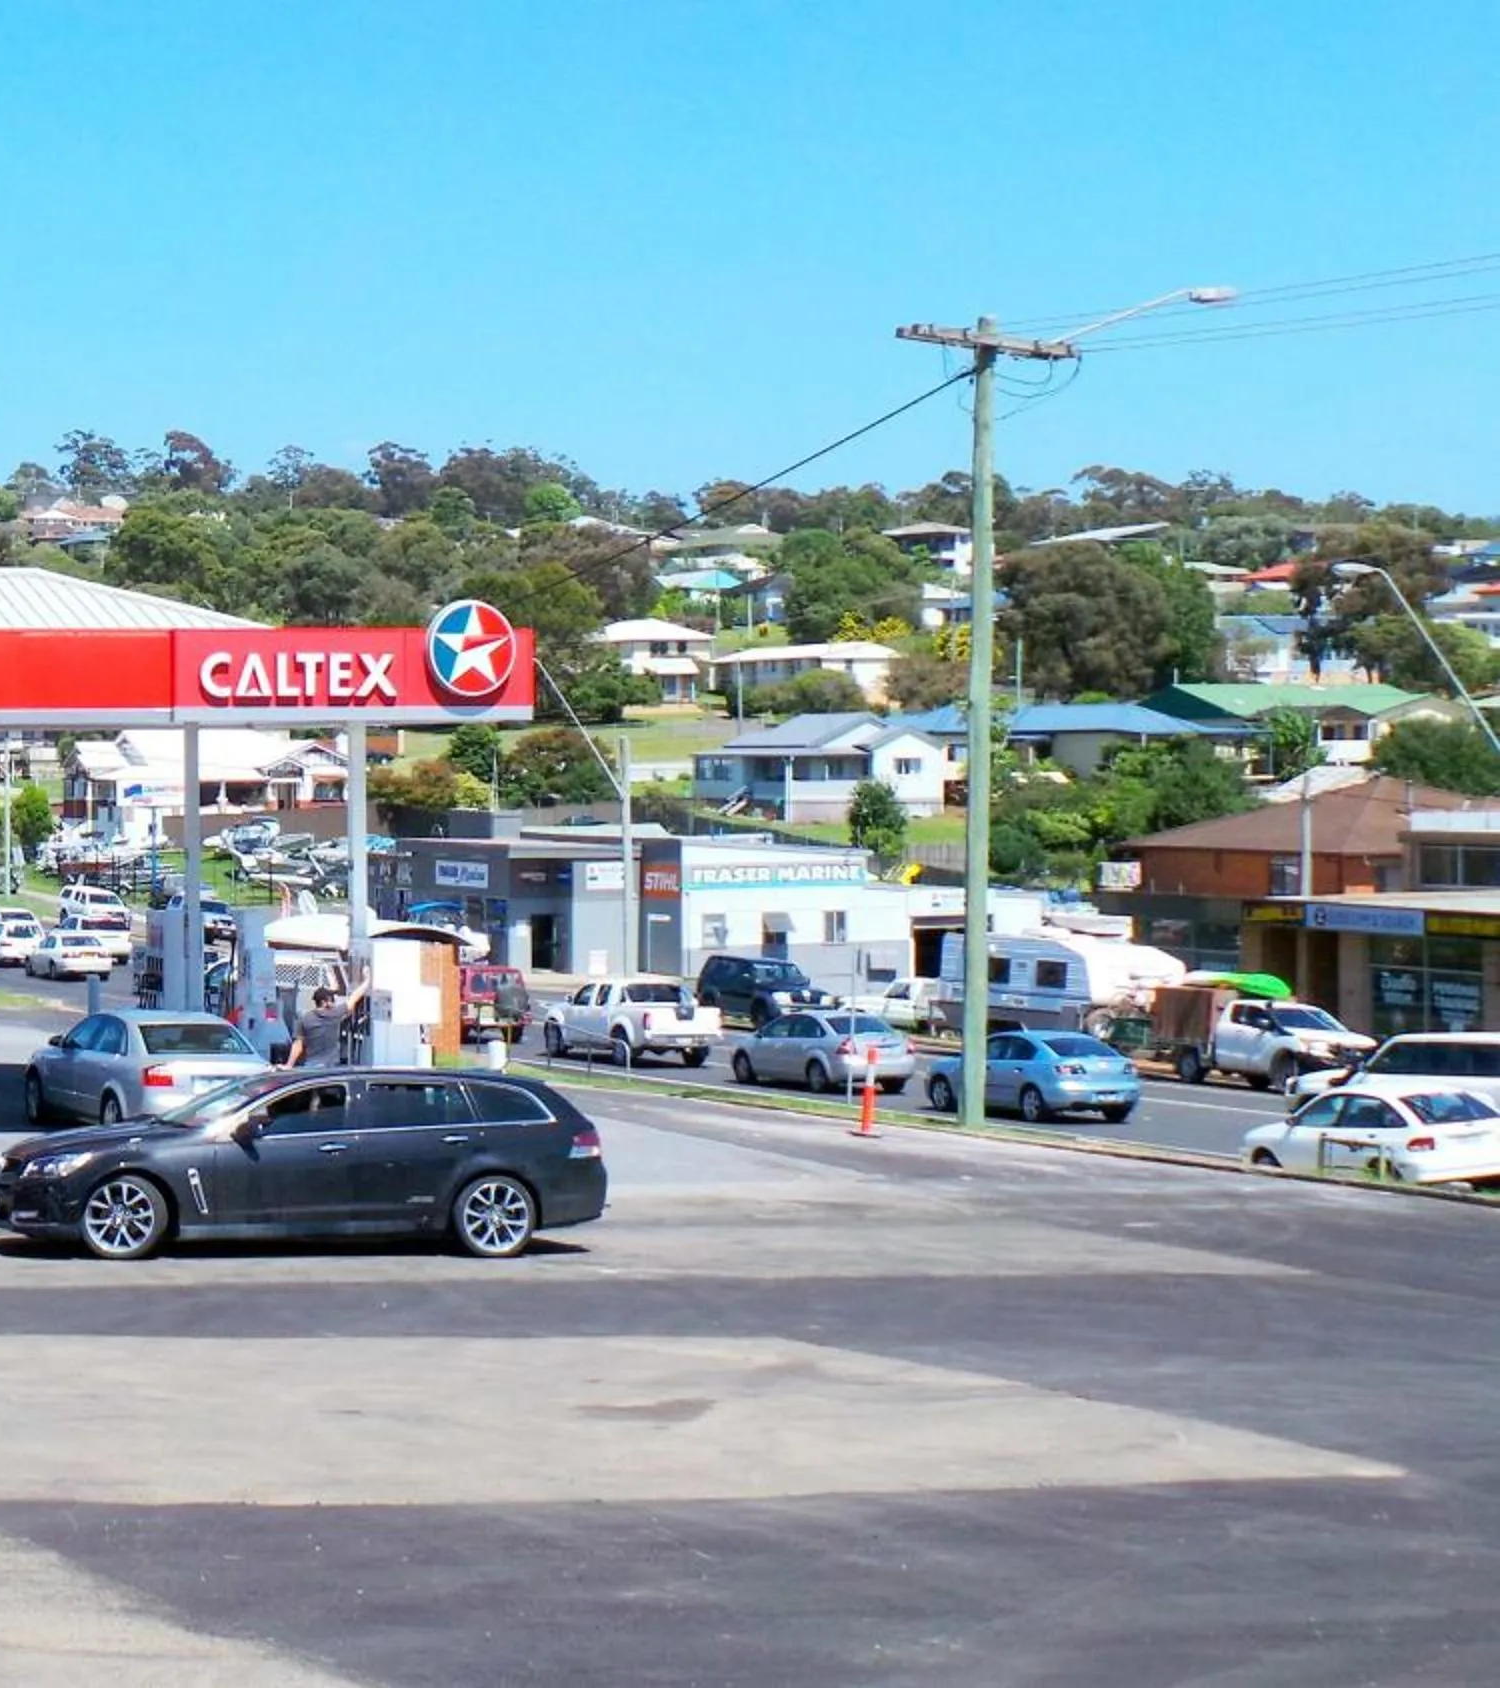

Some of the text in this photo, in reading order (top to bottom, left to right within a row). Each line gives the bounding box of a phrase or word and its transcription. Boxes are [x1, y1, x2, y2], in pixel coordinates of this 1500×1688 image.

[200, 652, 397, 698] CALTEX
[644, 872, 679, 891] STIHL
[691, 867, 771, 884] FRASER
